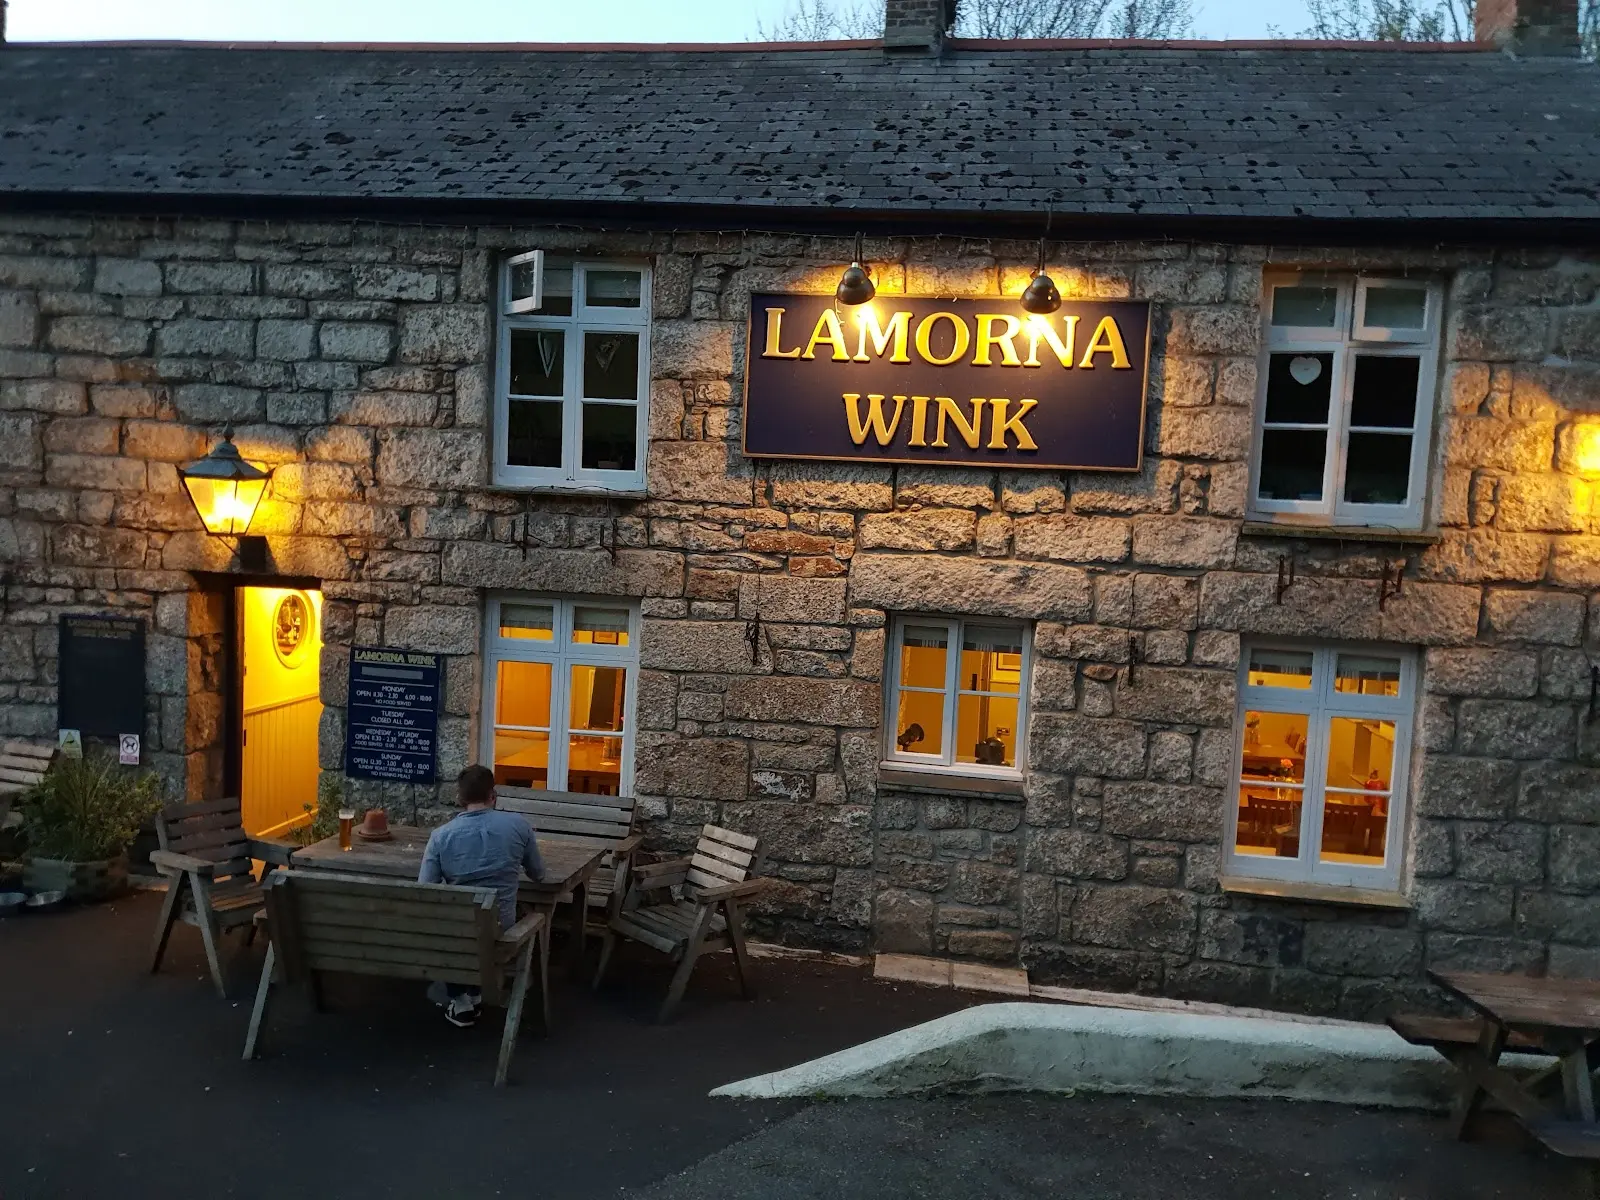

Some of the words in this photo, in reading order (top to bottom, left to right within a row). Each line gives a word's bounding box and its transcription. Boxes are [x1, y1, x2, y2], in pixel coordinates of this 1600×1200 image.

[761, 307, 1132, 369] LAMORNA
[842, 393, 1039, 451] WINK
[354, 650, 405, 662] LAMORNA
[408, 654, 436, 666] WINK
